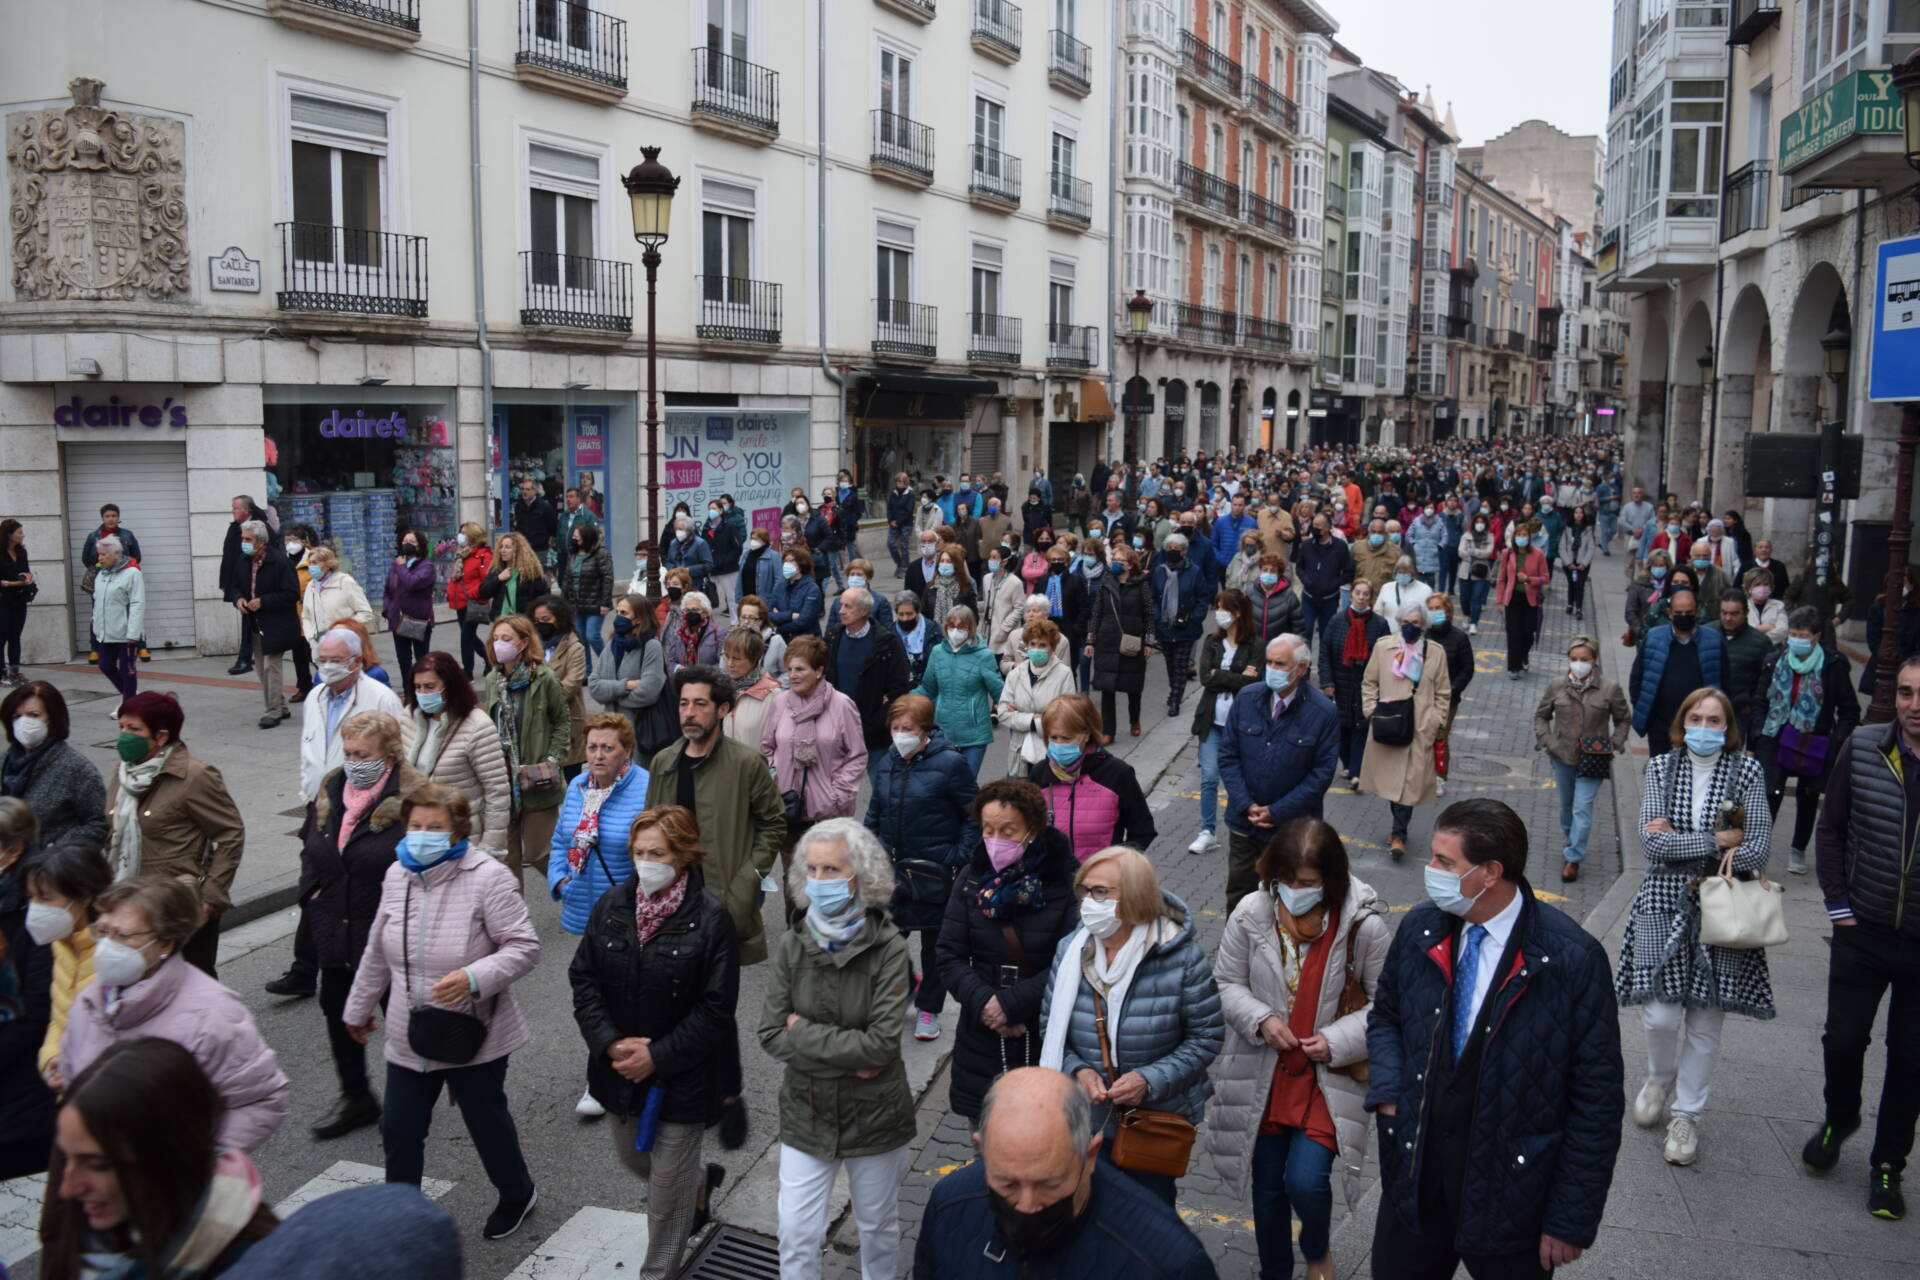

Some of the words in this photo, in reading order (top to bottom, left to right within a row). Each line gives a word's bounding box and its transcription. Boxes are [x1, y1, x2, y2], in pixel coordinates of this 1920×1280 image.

[1798, 89, 1834, 142] YES
[1780, 136, 1820, 170] LANGUAGES
[1822, 115, 1856, 147] CENTER
[220, 260, 251, 271] CALLE
[217, 276, 256, 287] SANTANDER
[54, 395, 188, 428] claire's
[319, 409, 407, 438] claire's
[737, 413, 777, 431] claire's
[576, 441, 602, 450] GRATIS
[663, 435, 699, 459] UN
[742, 451, 781, 470] YOU
[677, 468, 701, 484] SELFIE
[735, 470, 783, 488] LOOK
[733, 488, 782, 506] amazing
